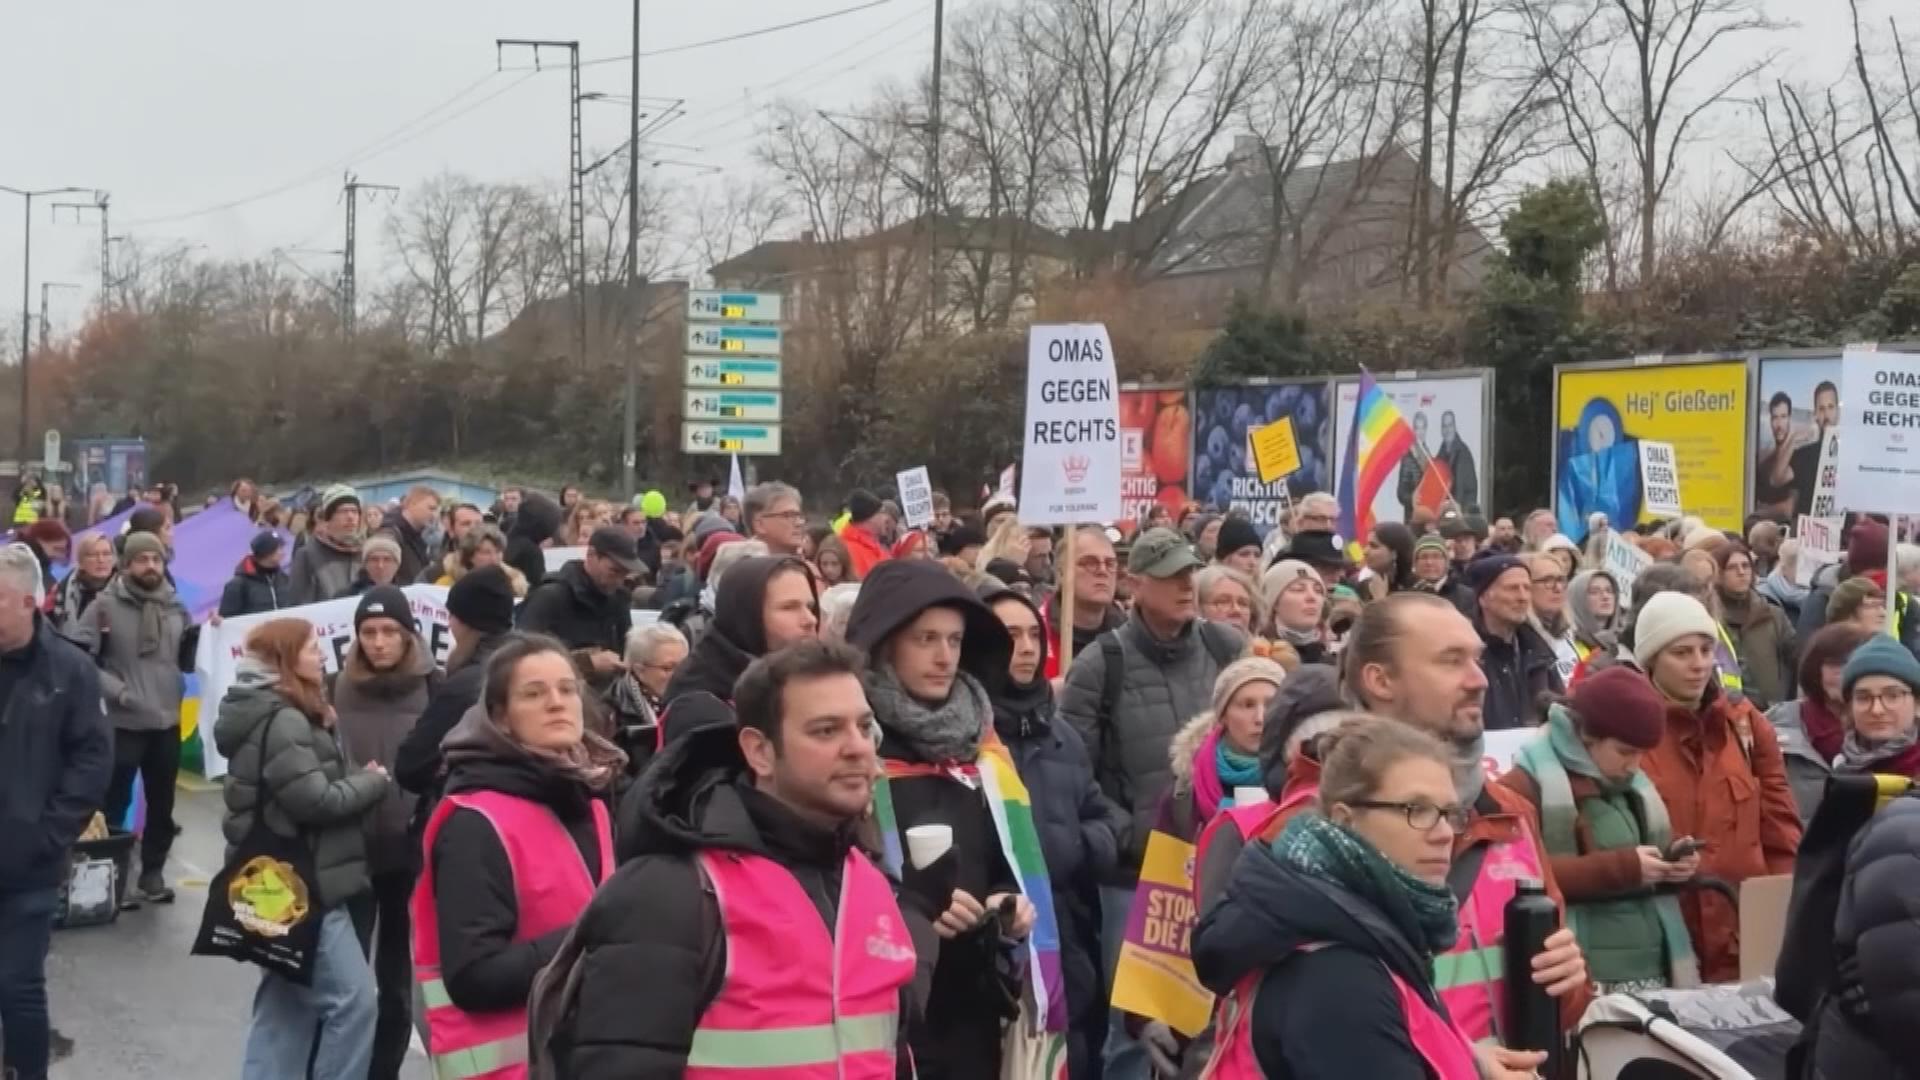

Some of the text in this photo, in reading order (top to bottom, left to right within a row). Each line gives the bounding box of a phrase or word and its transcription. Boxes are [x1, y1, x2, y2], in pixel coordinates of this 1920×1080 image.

[1049, 339, 1103, 362] OMAS
[1874, 370, 1920, 388] OMA
[1041, 379, 1110, 404] GEGEN
[1665, 388, 1735, 412] Gießen!
[1868, 391, 1920, 408] GEGE
[1034, 419, 1116, 444] RECHTS
[1147, 889, 1196, 923] STOP
[1143, 917, 1179, 950] DIE
